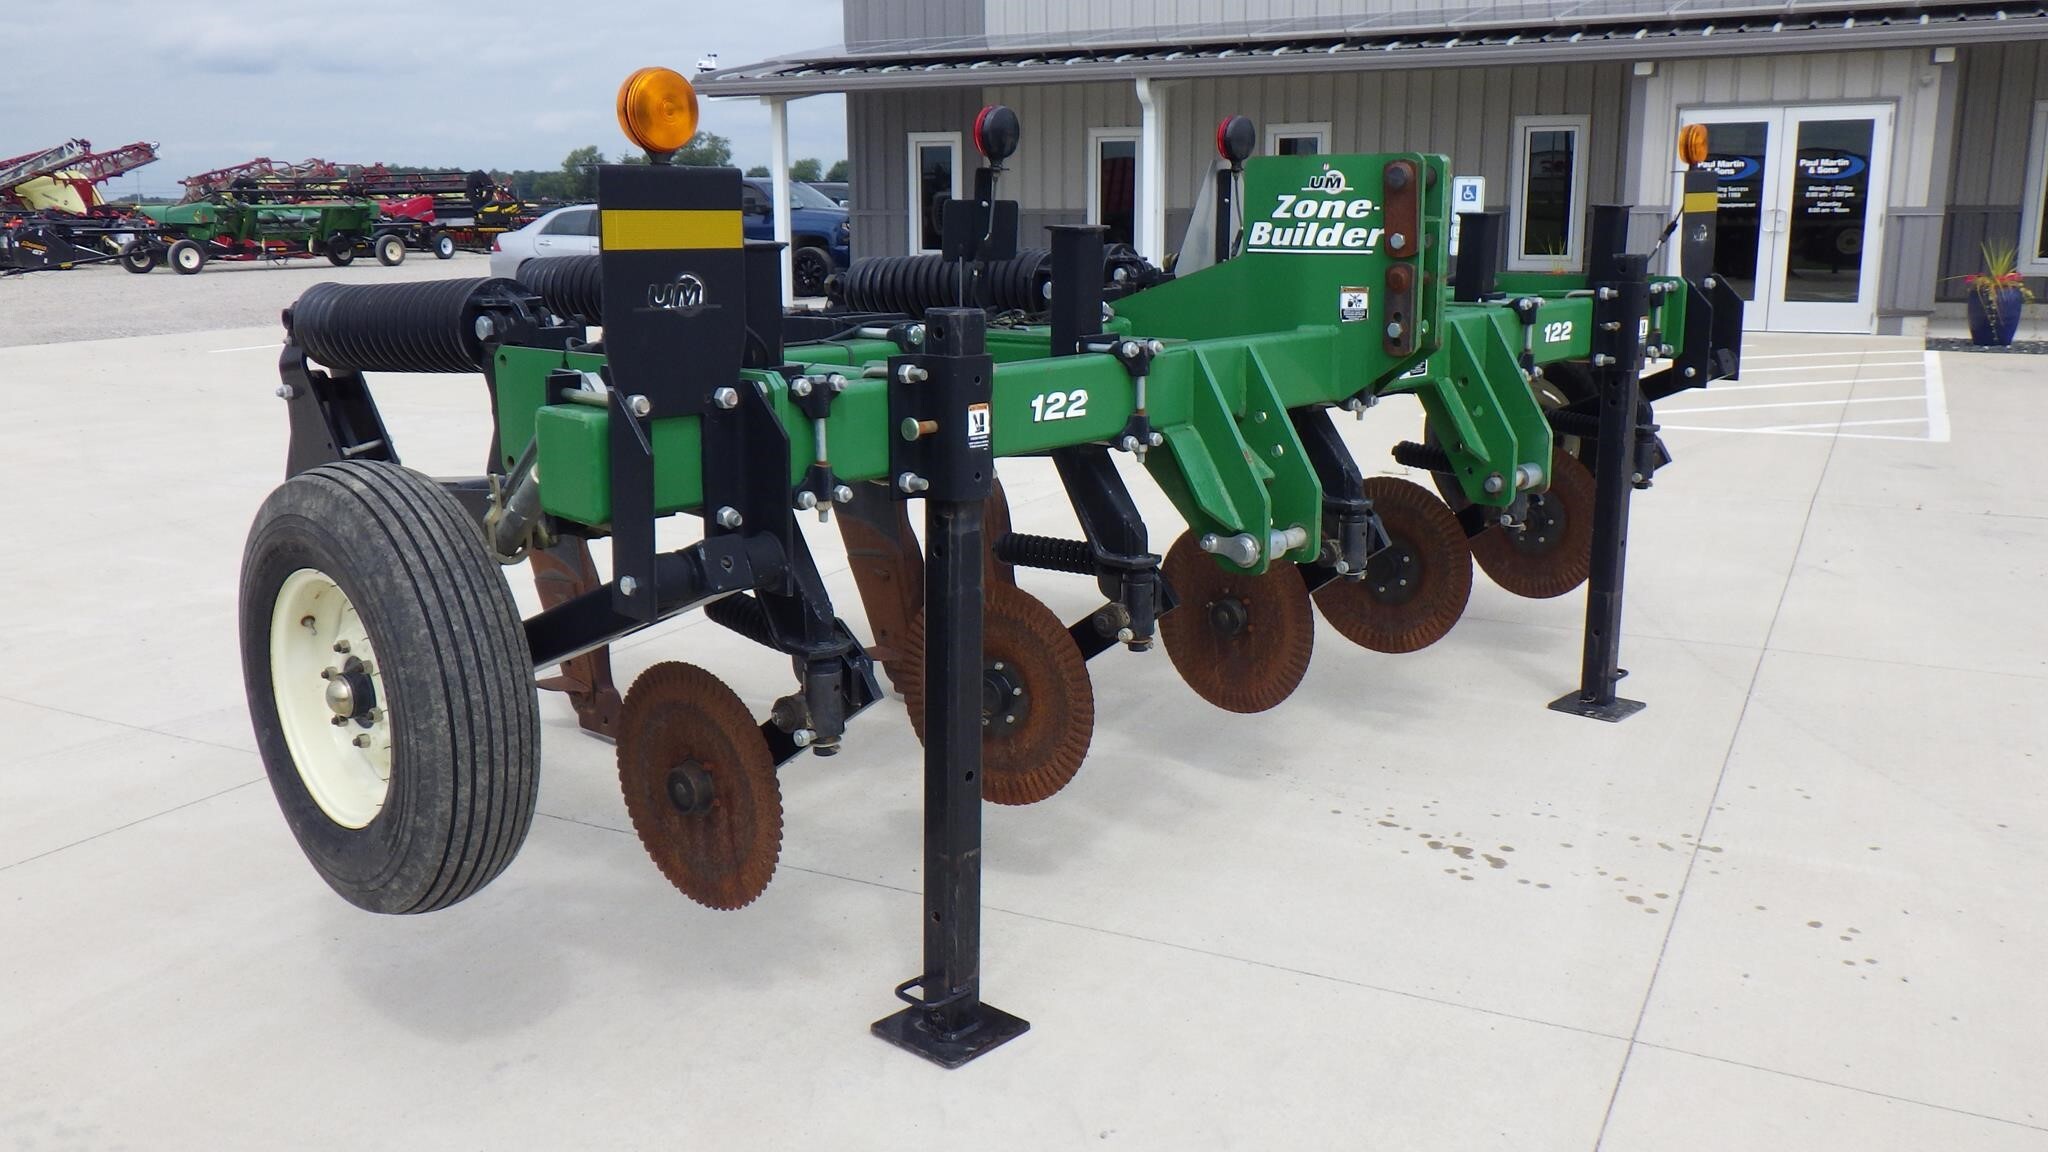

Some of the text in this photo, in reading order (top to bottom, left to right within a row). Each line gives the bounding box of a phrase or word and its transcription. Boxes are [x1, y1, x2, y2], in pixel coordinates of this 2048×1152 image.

[1697, 160, 1746, 169] Paul Martin
[1799, 158, 1850, 167] Paul Martin
[1817, 166, 1840, 174] Sons
[1309, 175, 1342, 189] UM
[1271, 194, 1381, 219] Zone-
[1248, 221, 1385, 247] Builder
[1544, 320, 1573, 343] 122
[1030, 388, 1089, 422] 122
